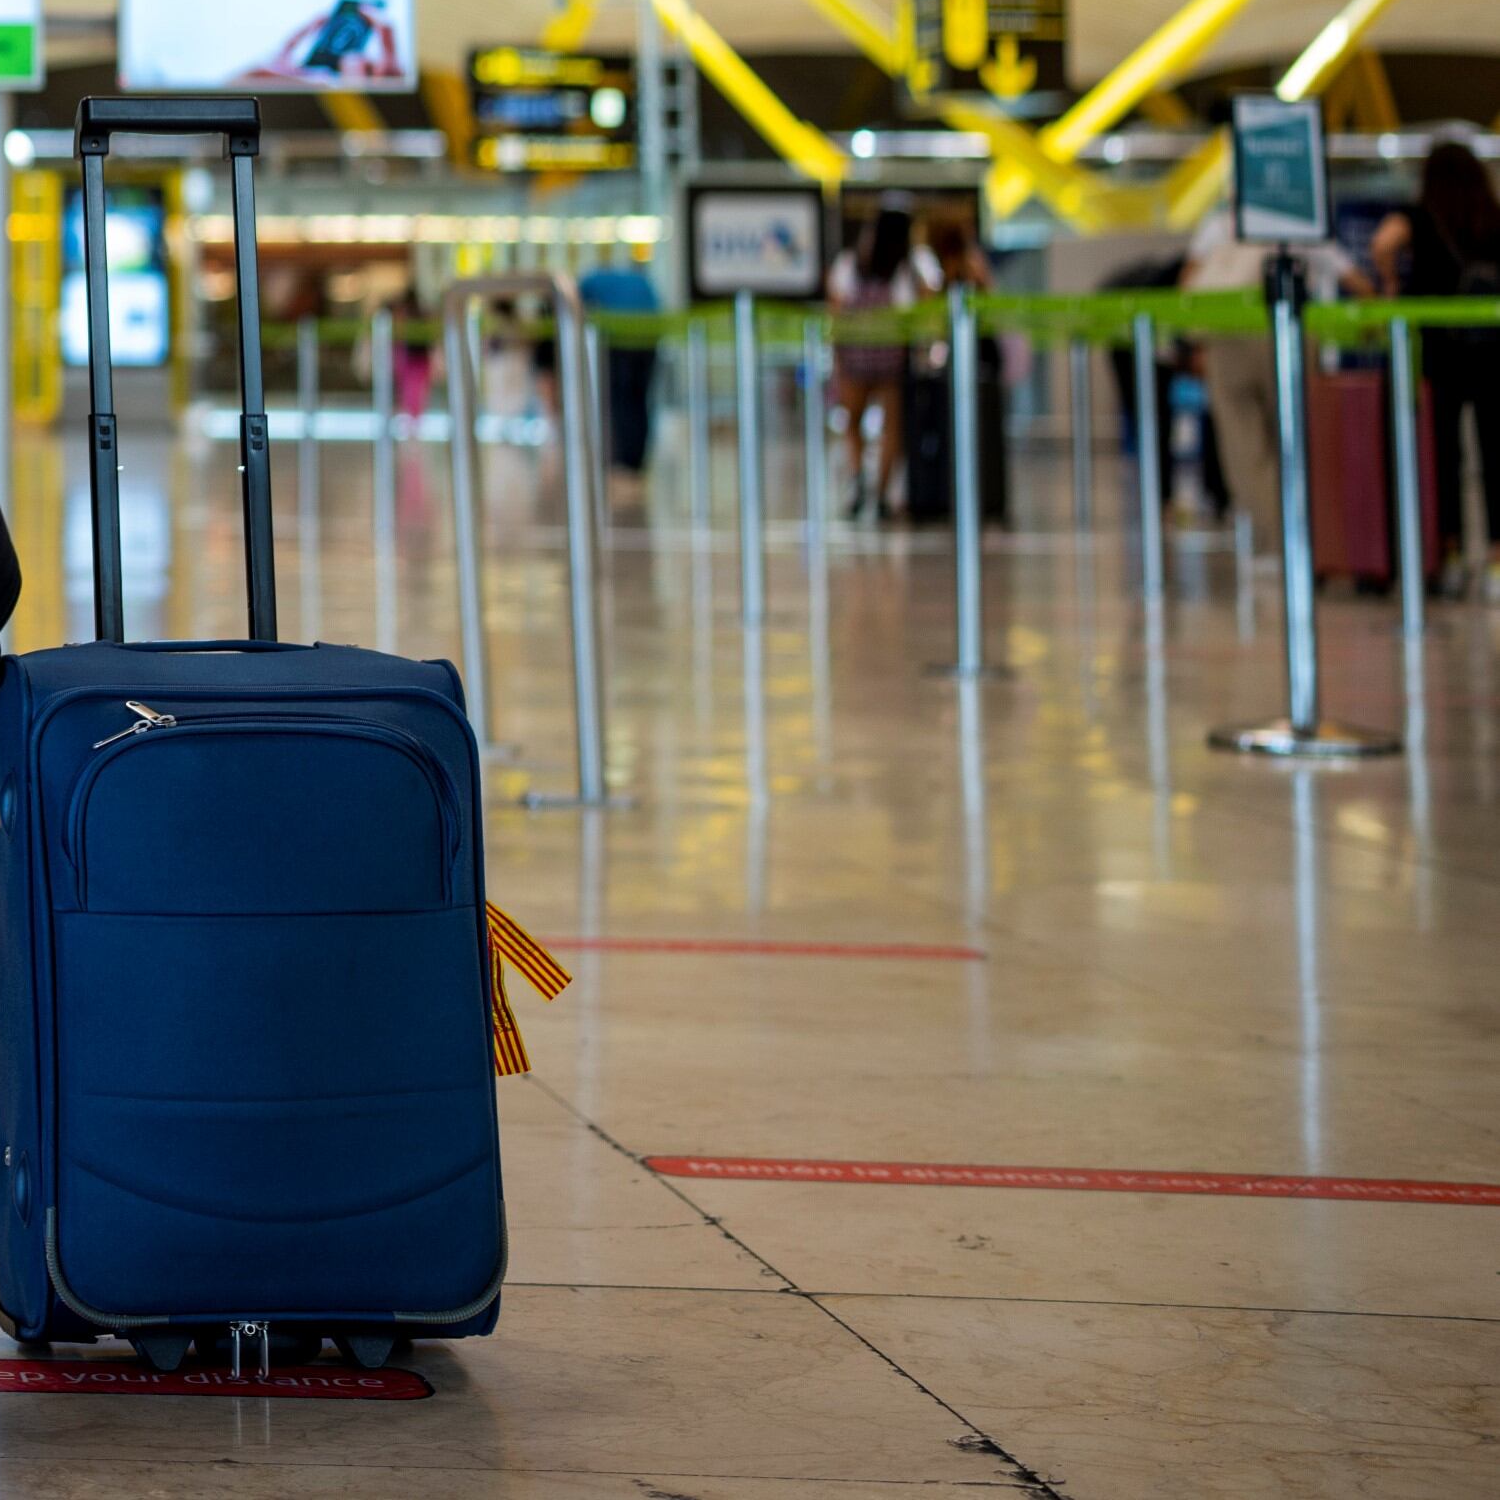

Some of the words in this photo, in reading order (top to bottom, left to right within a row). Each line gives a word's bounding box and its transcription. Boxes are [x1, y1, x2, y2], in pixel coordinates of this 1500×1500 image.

[688, 1161, 843, 1176] Mantén
[854, 1166, 890, 1178] la
[902, 1167, 1088, 1184] distancia
[62, 1371, 163, 1386] your
